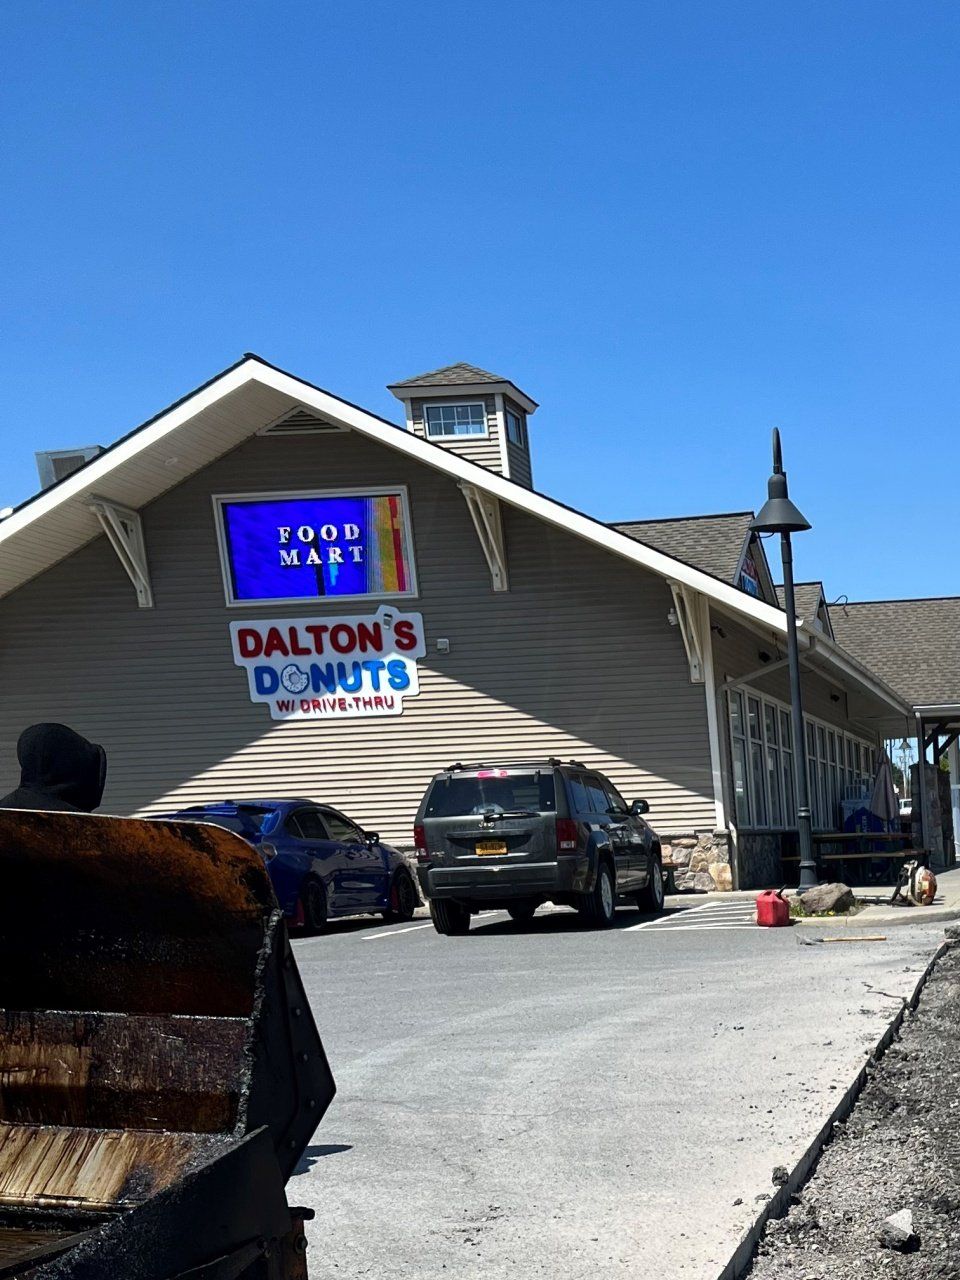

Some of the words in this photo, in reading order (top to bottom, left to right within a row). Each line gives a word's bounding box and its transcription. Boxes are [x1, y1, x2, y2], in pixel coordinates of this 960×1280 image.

[277, 523, 360, 544] FOOD
[279, 545, 364, 566] MART
[237, 613, 418, 658] DALTON'S
[253, 659, 411, 696] DONUTS
[276, 699, 296, 713] W/
[299, 695, 396, 713] DRIVE-THRU
